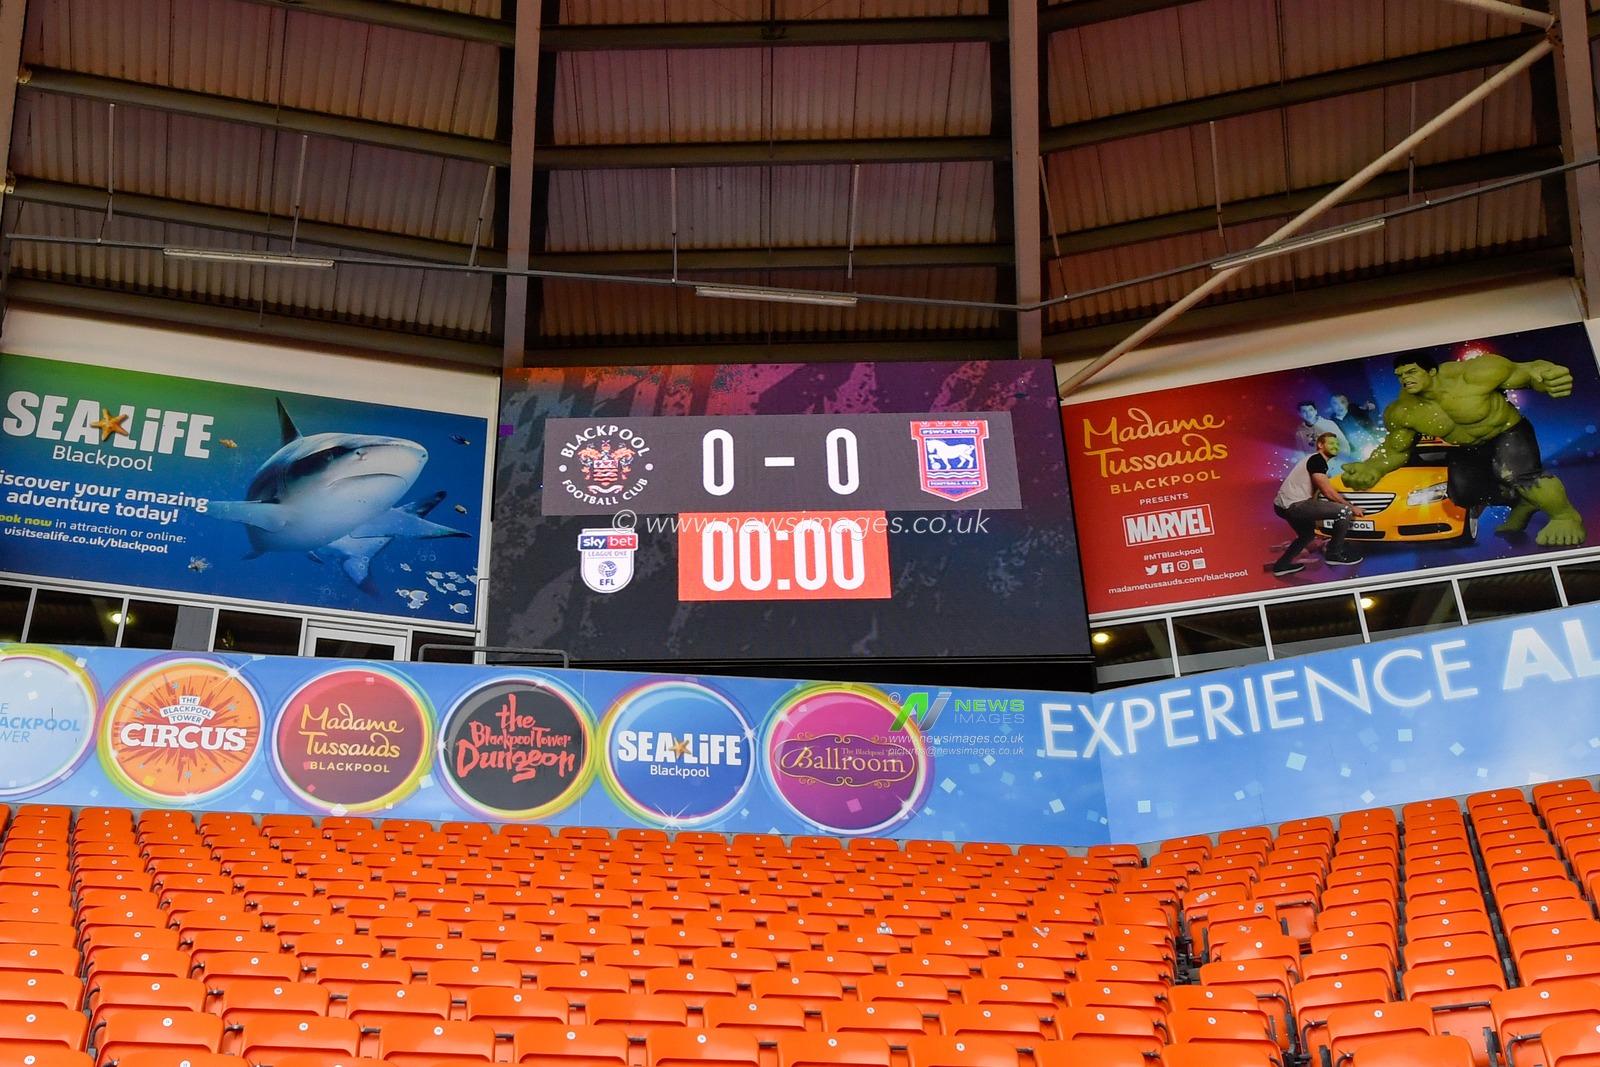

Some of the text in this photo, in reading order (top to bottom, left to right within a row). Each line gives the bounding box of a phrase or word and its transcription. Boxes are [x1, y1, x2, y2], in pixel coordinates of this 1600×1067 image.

[2, 390, 100, 445] SEA
[1083, 407, 1225, 449] Madame
[560, 424, 651, 458] BLACKPOOL
[1083, 433, 1228, 478] Tussauds
[52, 445, 153, 472] Blackpool
[702, 428, 860, 496] 0 - 0
[0, 470, 209, 513] iscover your amazing
[562, 477, 649, 506] FOOTBALL CLUB
[1110, 470, 1221, 495] BLACKPOOL
[6, 490, 178, 525] adventure today!
[1139, 493, 1189, 506] PRESENTS
[0, 514, 186, 543] ook now in attraction or online:
[4, 526, 168, 553] visitsealife.co.uk/blackpool
[1126, 507, 1211, 544] MARVEL
[583, 536, 633, 548] sky bet
[702, 518, 865, 591] 00:00
[1143, 547, 1204, 561] #MTBlackpool
[1108, 569, 1249, 594] madametussauds.com/blackpool
[1041, 619, 1600, 759] EXPERIENCE AL
[0, 716, 80, 731] ACKPOOL
[162, 705, 212, 717] BLACKPOOL
[171, 714, 202, 724] TOWER
[300, 703, 404, 733] Madame
[495, 693, 536, 732] the
[120, 723, 247, 751] CIRCUS
[298, 731, 400, 759] Tussauds
[468, 720, 571, 752] Blackpool Tower
[617, 730, 673, 763] SEA
[456, 739, 575, 784] Dungeon
[780, 745, 906, 773] Ballroom
[842, 747, 853, 755] The
[310, 761, 391, 773] BLACKPOOL
[650, 764, 710, 779] Blackpool
